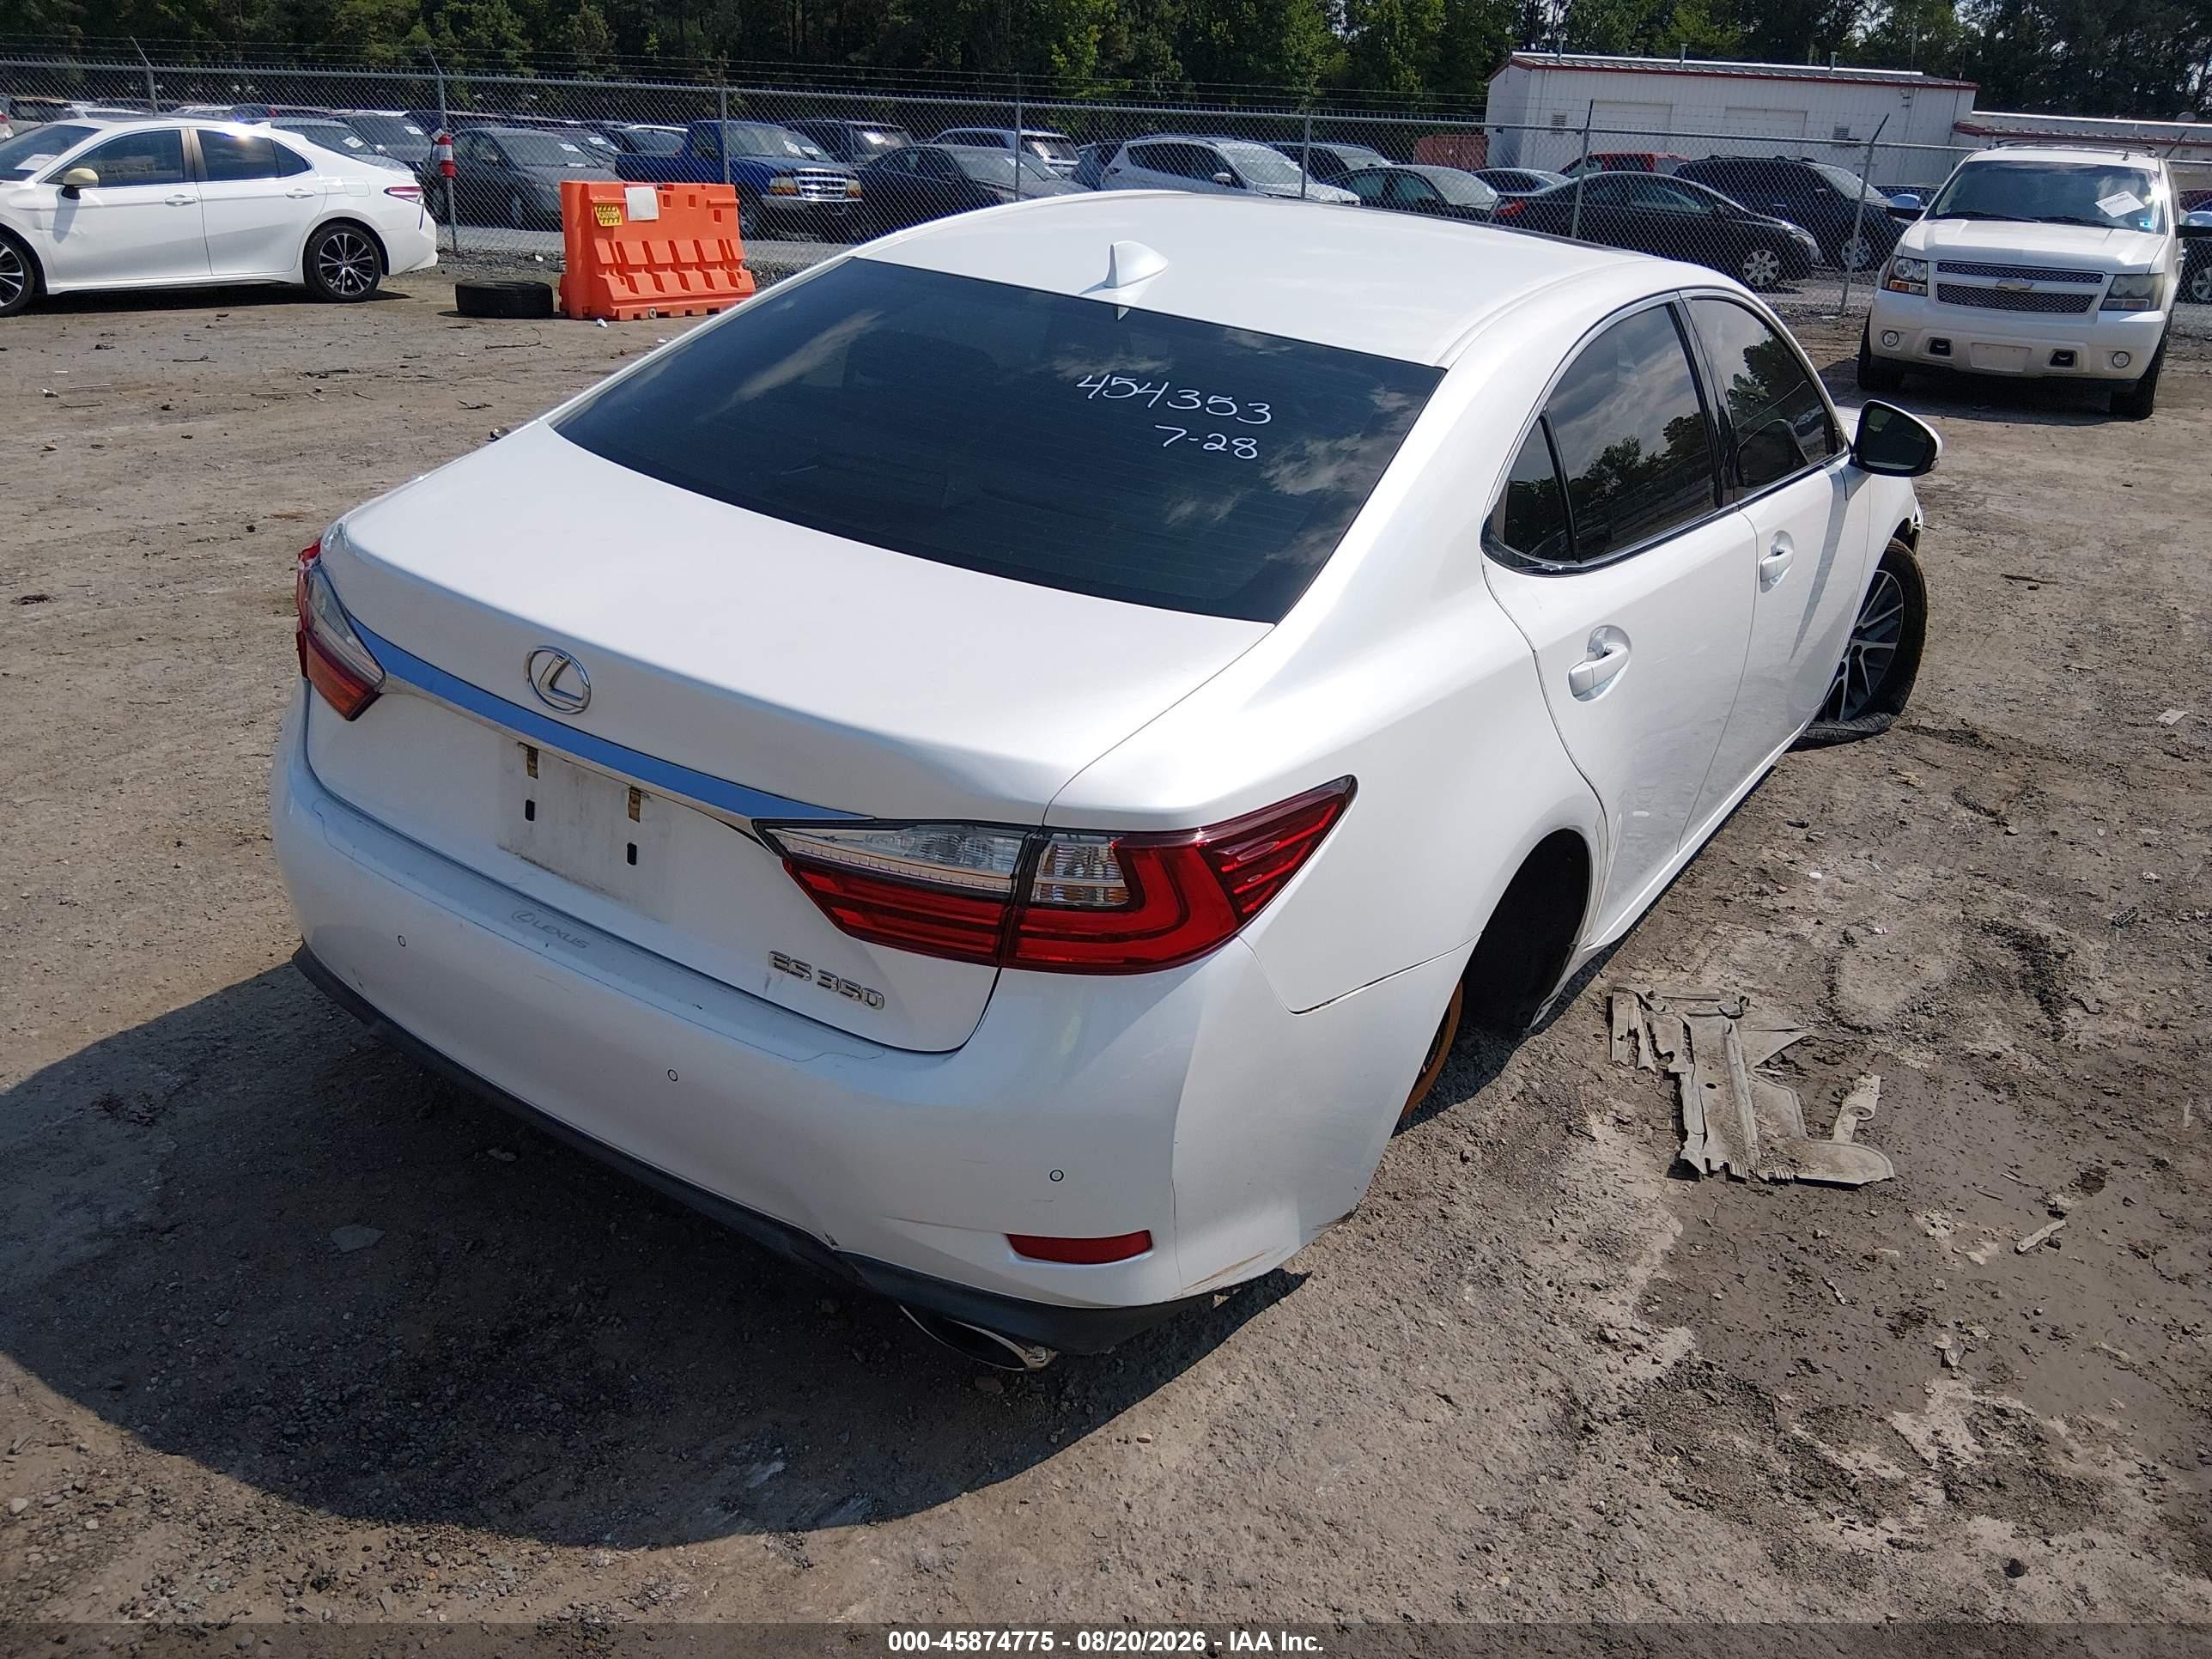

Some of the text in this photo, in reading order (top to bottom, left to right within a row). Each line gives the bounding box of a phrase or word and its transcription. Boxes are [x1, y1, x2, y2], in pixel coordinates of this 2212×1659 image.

[1076, 374, 1272, 424] 454353
[1154, 424, 1259, 459] 7-28
[532, 920, 590, 949] LEXUS
[769, 950, 885, 1011] ES 350
